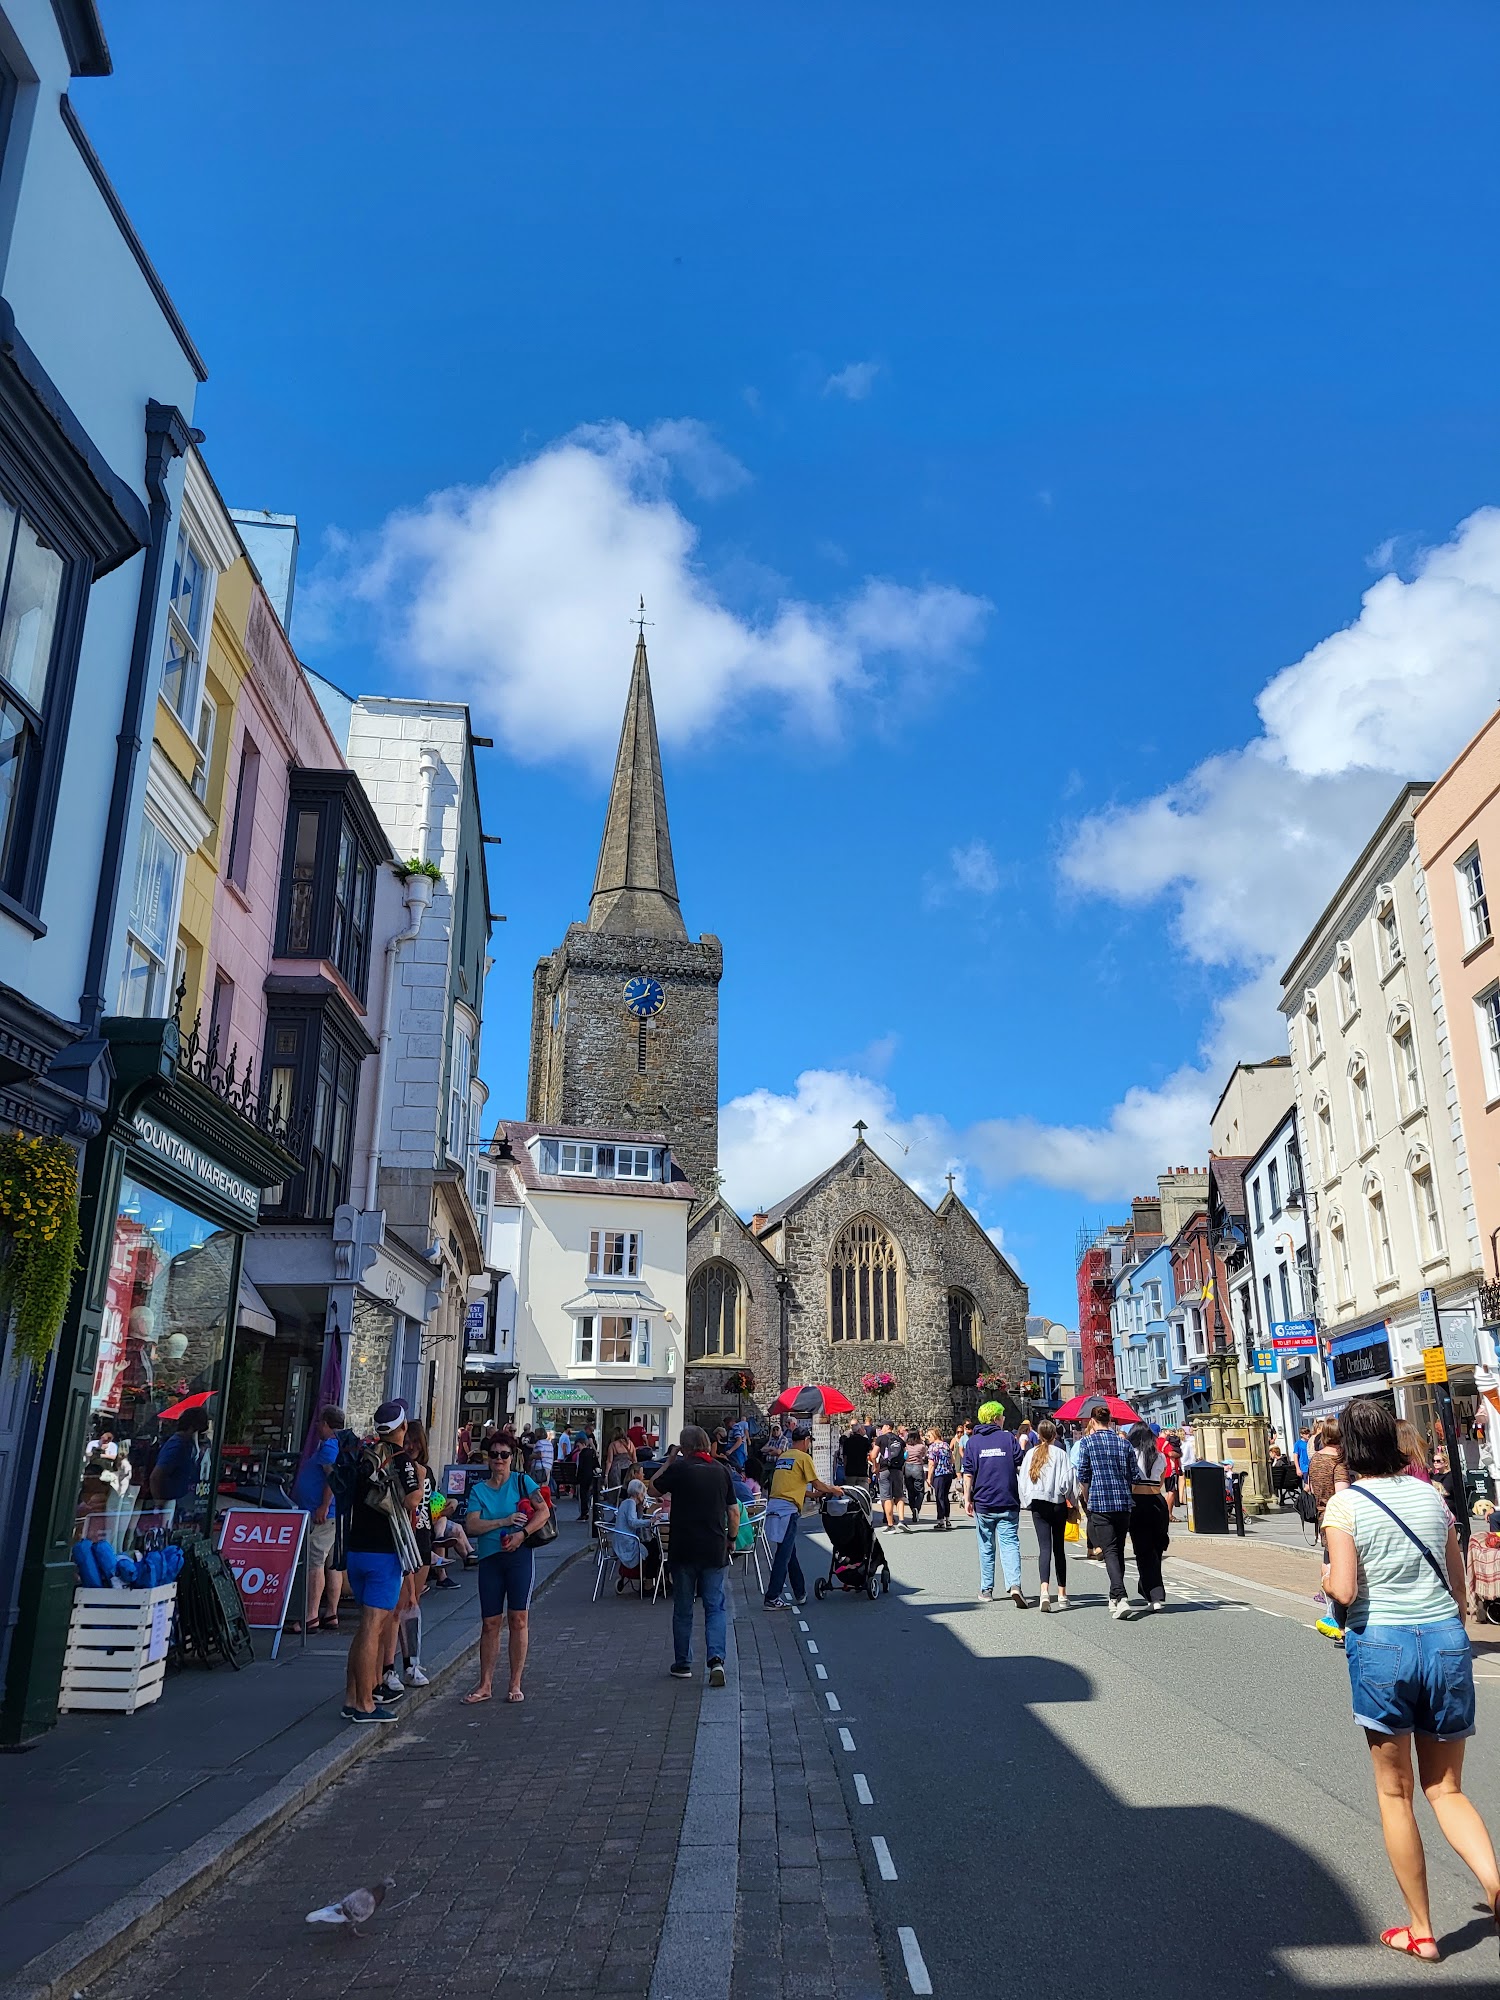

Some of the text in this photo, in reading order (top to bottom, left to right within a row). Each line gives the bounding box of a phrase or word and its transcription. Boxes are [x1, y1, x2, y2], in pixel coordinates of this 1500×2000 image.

[133, 1115, 258, 1211] MOUNTAIN WAREHOUSE
[1446, 1333, 1459, 1341] THE
[232, 1524, 294, 1545] SALE
